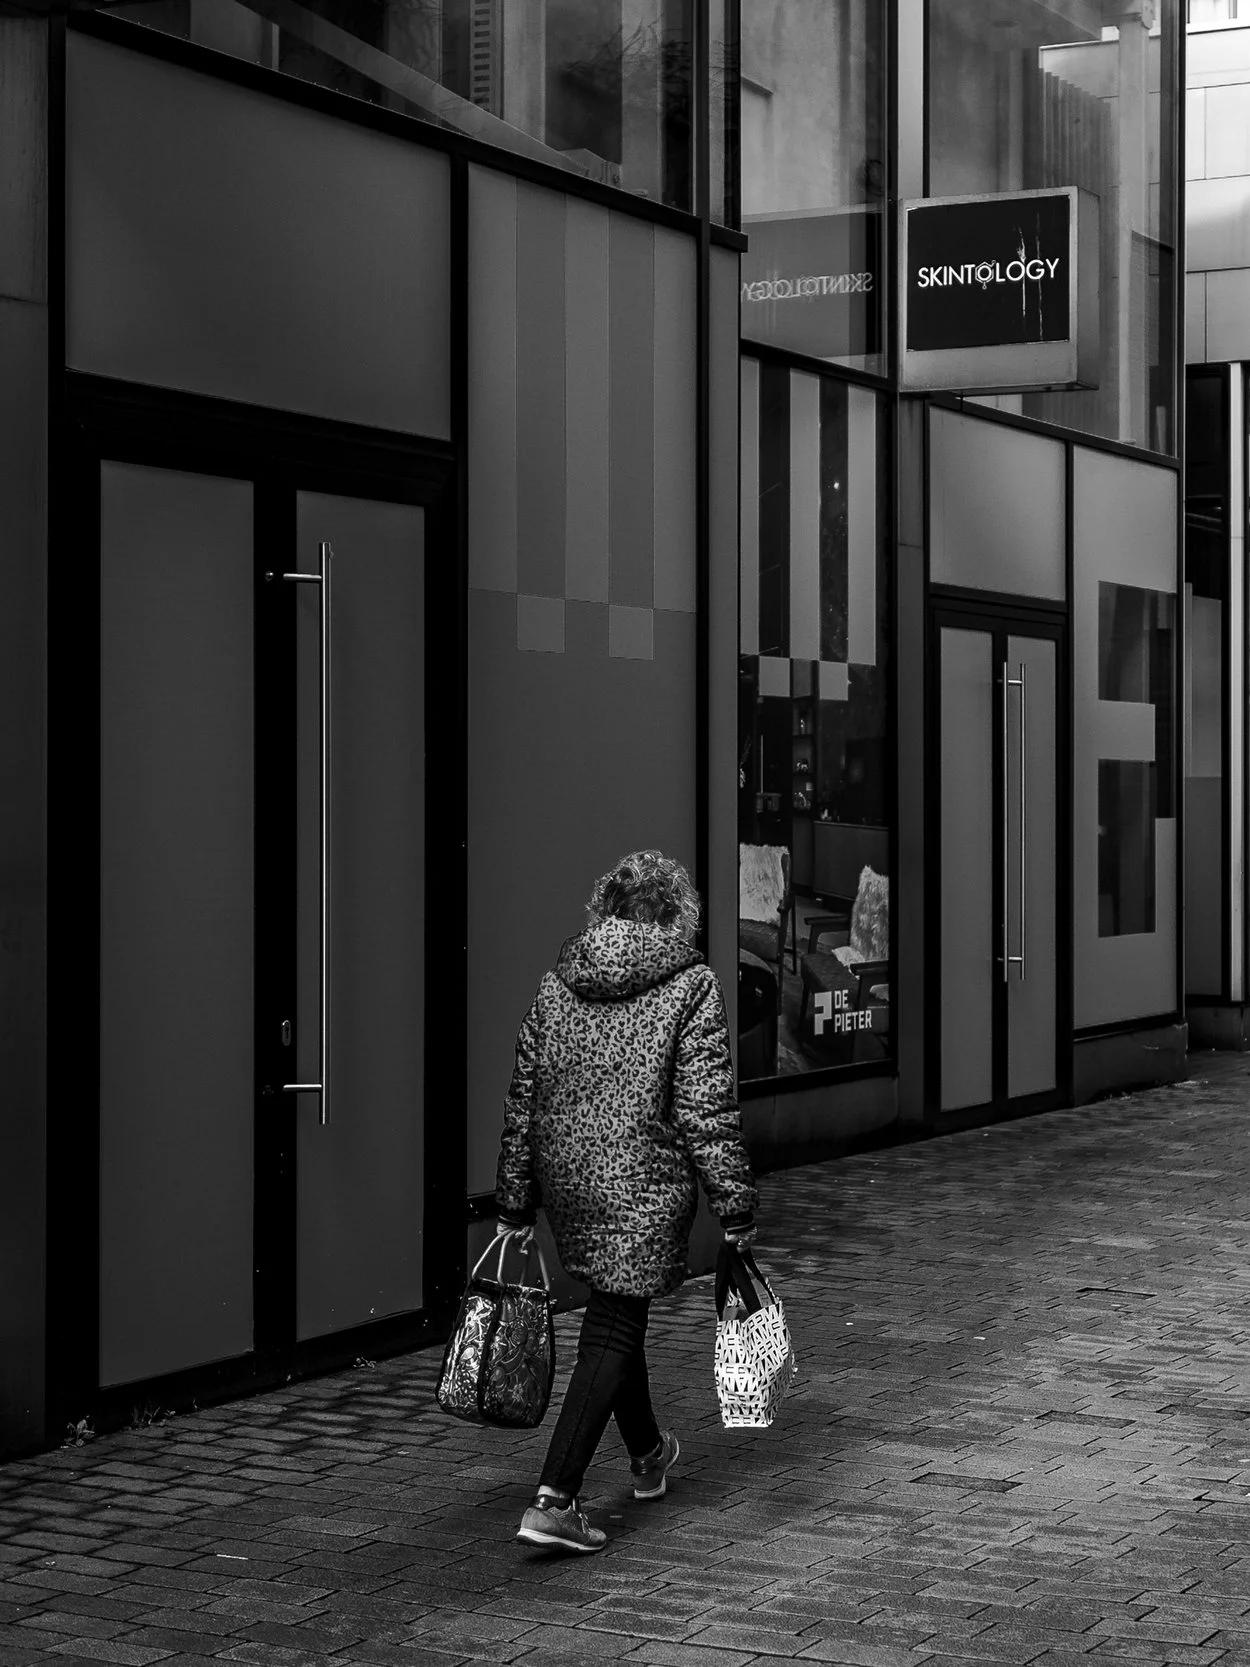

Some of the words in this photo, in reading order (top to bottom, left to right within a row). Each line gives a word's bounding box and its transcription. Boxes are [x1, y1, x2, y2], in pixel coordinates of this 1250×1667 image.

[917, 257, 1060, 289] SKINTOLOGY
[834, 989, 849, 1009] DE
[834, 1009, 872, 1033] PIETER
